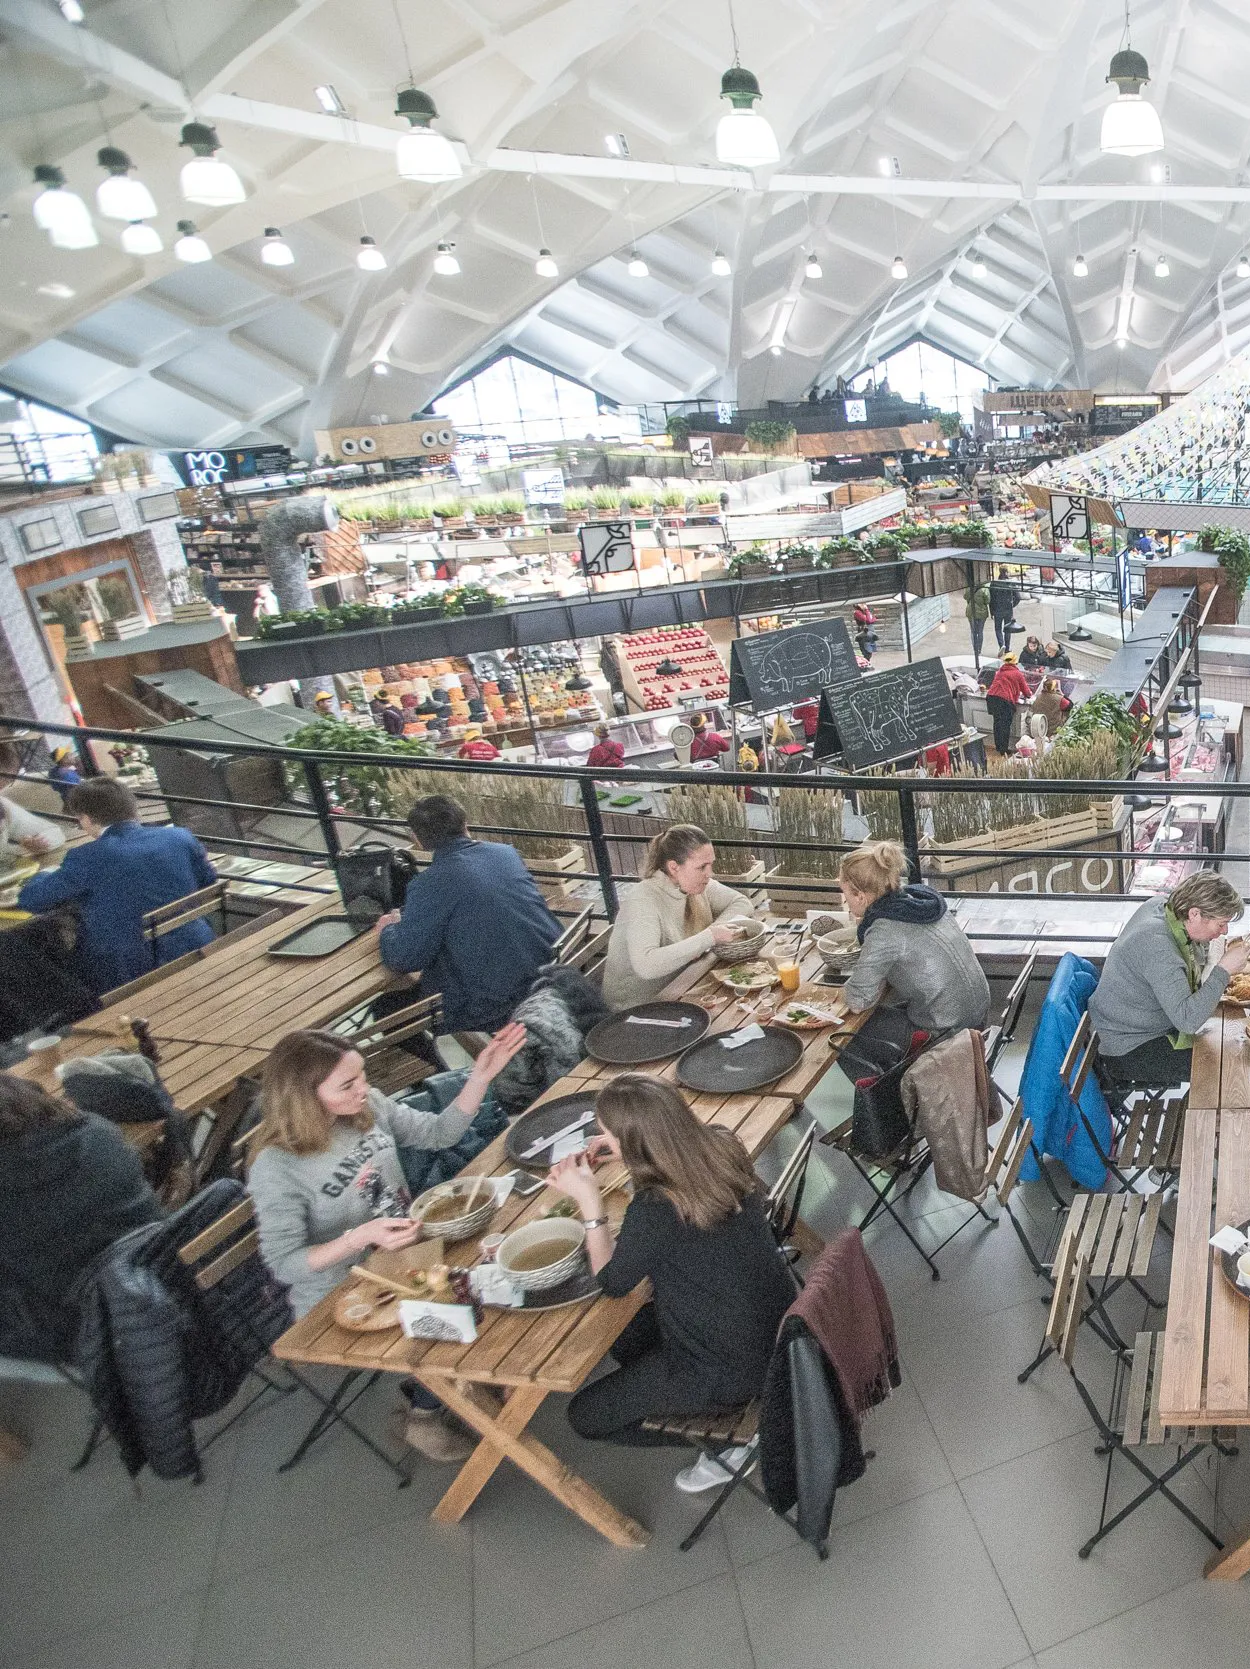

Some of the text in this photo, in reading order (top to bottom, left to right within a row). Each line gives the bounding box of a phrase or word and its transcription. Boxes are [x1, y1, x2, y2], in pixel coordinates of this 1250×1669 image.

[1010, 394, 1067, 409] ЩЕПКА
[185, 451, 225, 470] MO
[962, 857, 1114, 893] ЯСО
